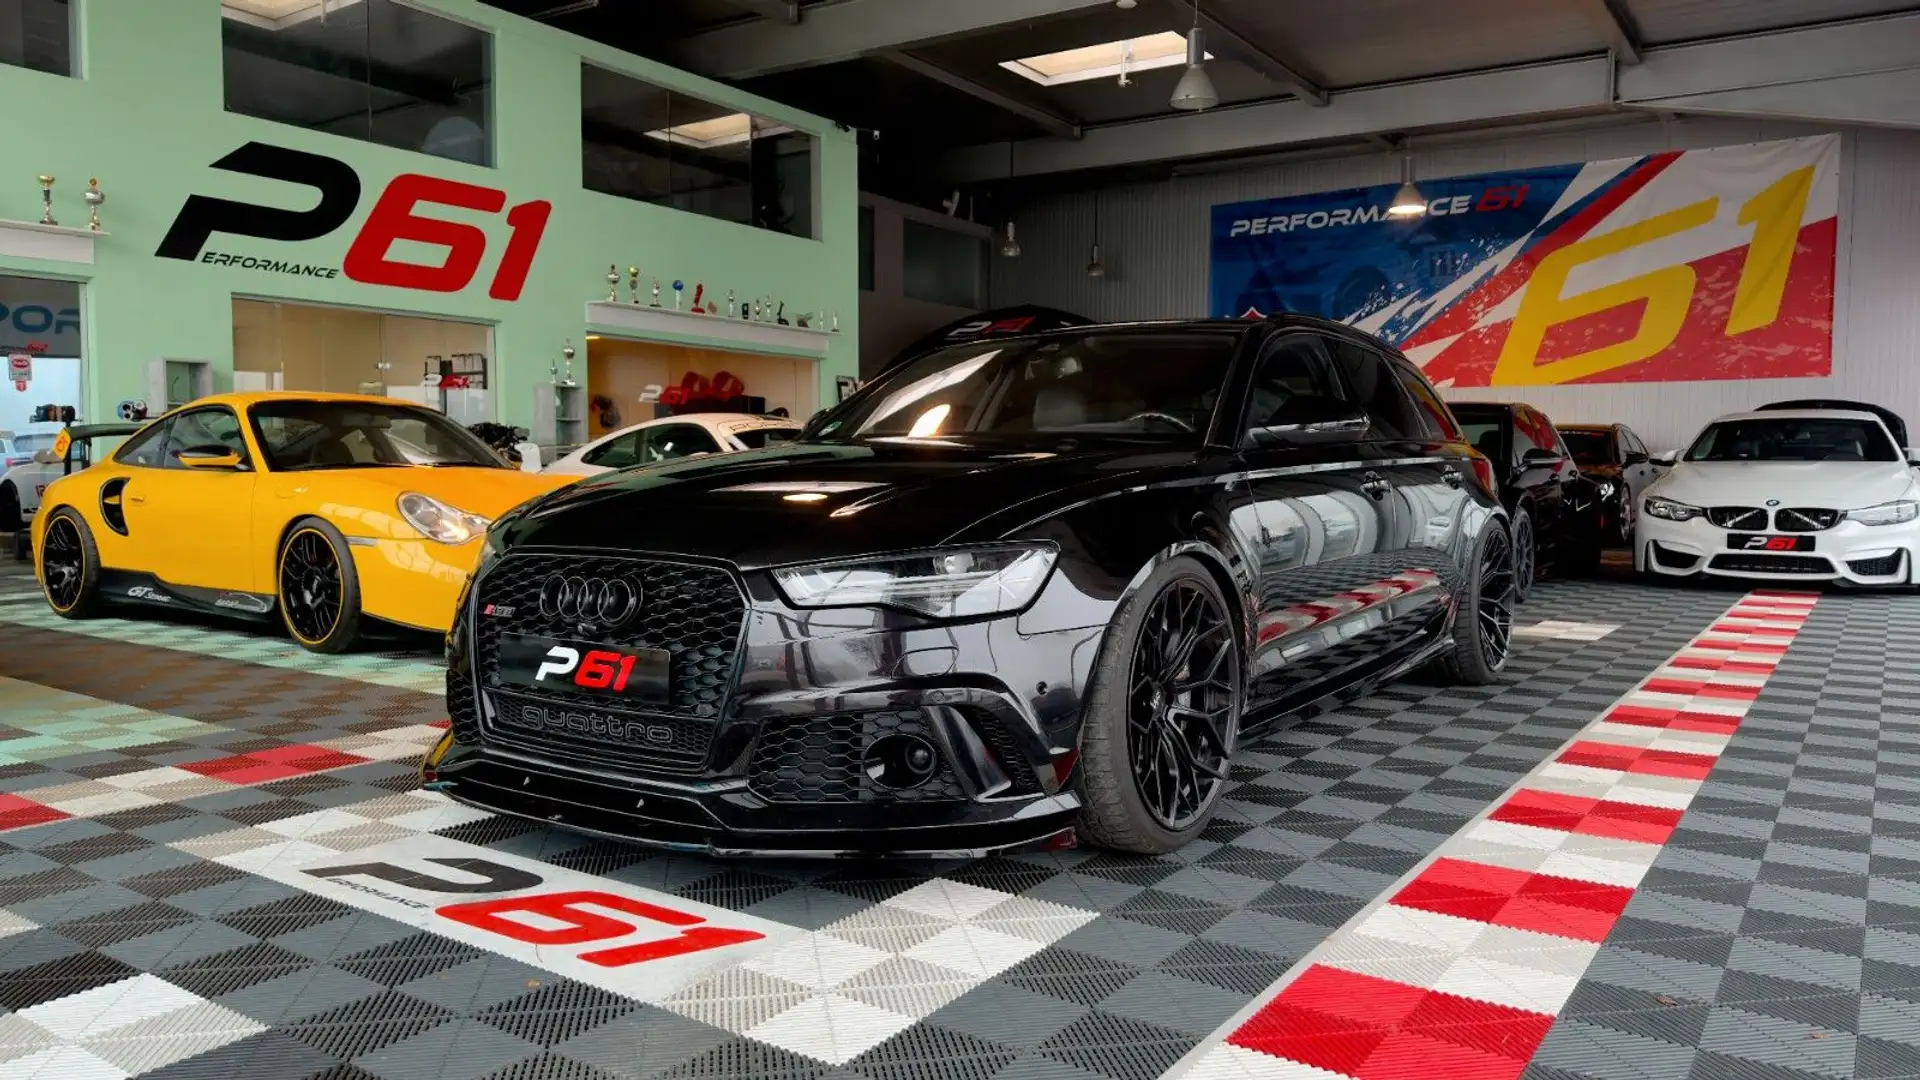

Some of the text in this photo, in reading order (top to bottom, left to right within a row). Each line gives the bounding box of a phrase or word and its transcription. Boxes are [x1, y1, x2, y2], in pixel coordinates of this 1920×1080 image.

[154, 141, 552, 302] P61
[1475, 184, 1530, 212] 61
[1490, 163, 1818, 388] 61
[1743, 536, 1798, 550] P61
[535, 645, 638, 692] P61
[521, 705, 674, 744] quattro
[300, 857, 767, 968] P61
